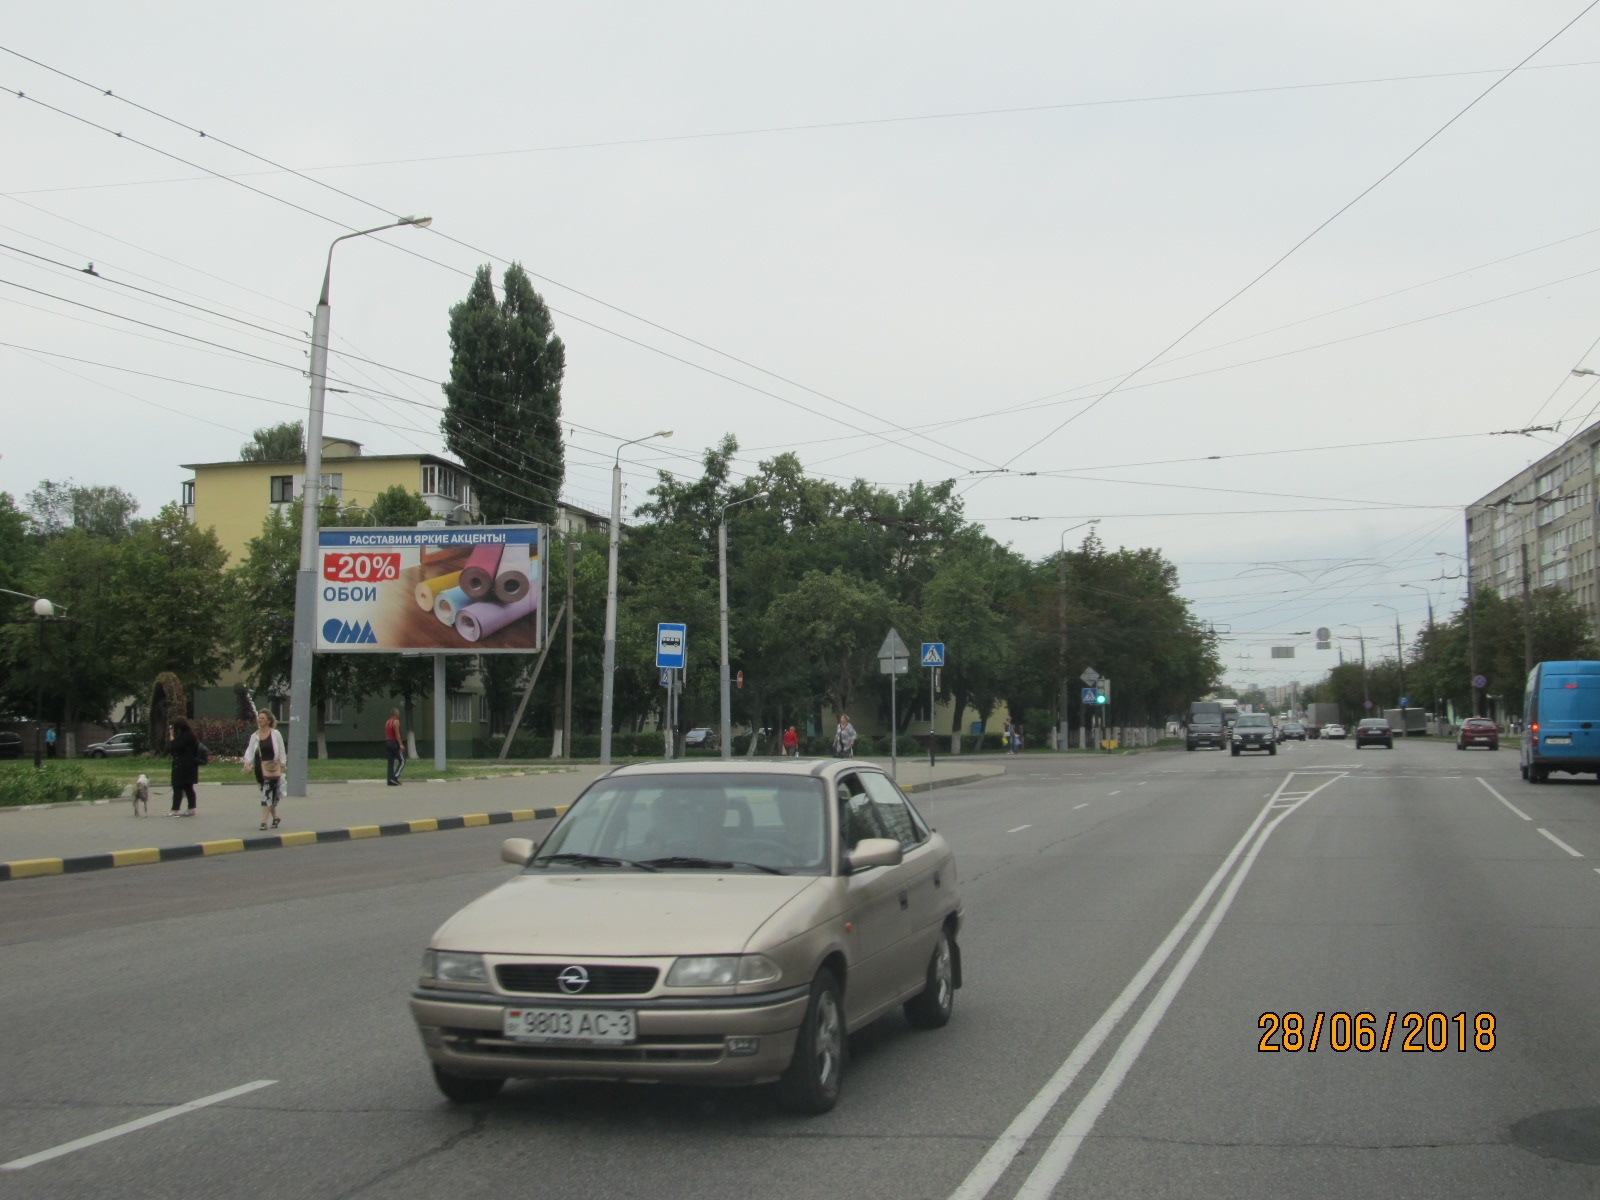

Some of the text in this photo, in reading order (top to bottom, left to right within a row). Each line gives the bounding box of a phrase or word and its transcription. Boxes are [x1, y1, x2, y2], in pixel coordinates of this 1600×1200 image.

[349, 533, 506, 545] РАССТАВИМ ЯРКИЕ АКЦЕНТЫ!
[327, 555, 395, 578] -20%
[323, 586, 376, 601] ОБОИ
[524, 1012, 631, 1036] 9803 AC-3
